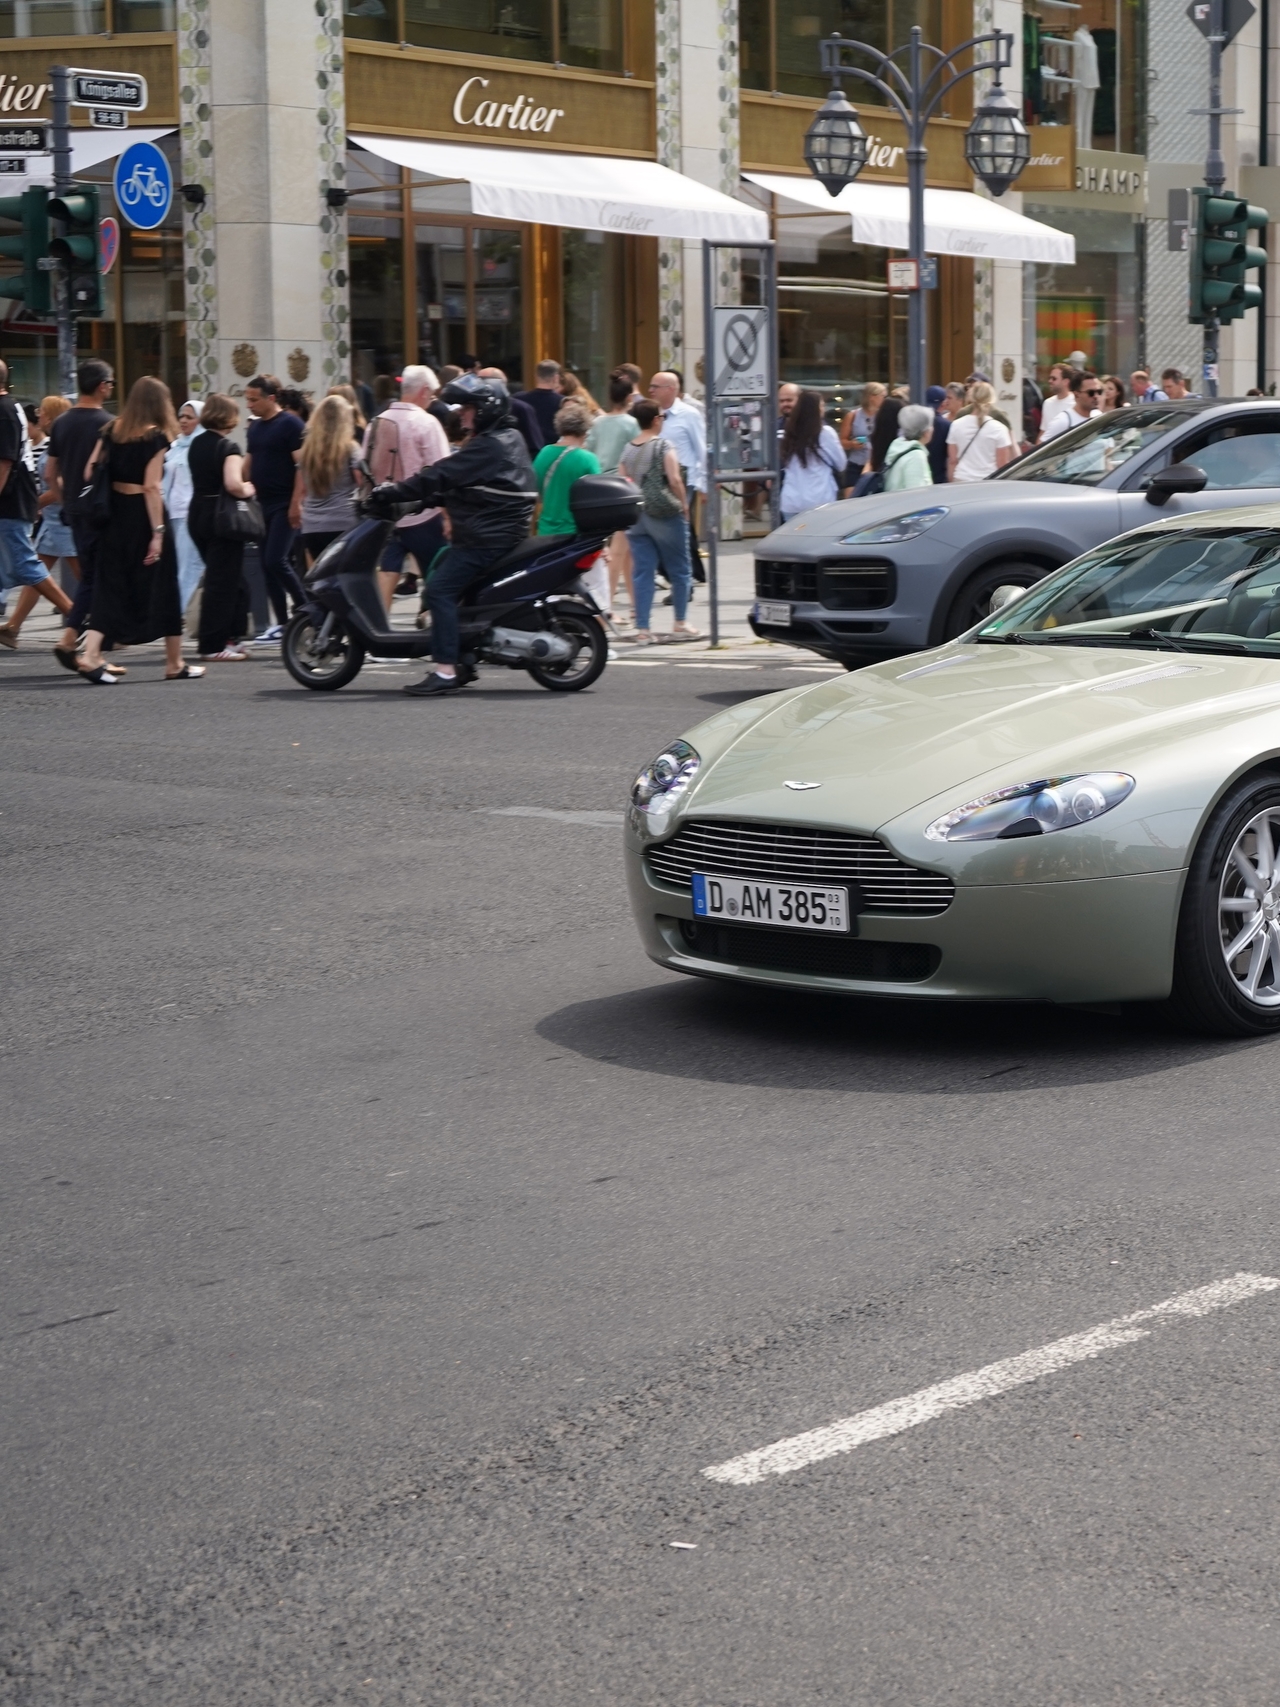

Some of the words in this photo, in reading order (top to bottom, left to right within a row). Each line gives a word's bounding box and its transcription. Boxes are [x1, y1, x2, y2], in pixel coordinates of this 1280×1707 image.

[79, 79, 139, 100] Königsallee
[452, 76, 566, 133] Cartier
[598, 200, 655, 231] Cartier
[708, 880, 723, 913] D
[741, 885, 772, 920] AM
[778, 888, 827, 925] 385
[828, 893, 840, 904] 03
[829, 916, 841, 927] 10
